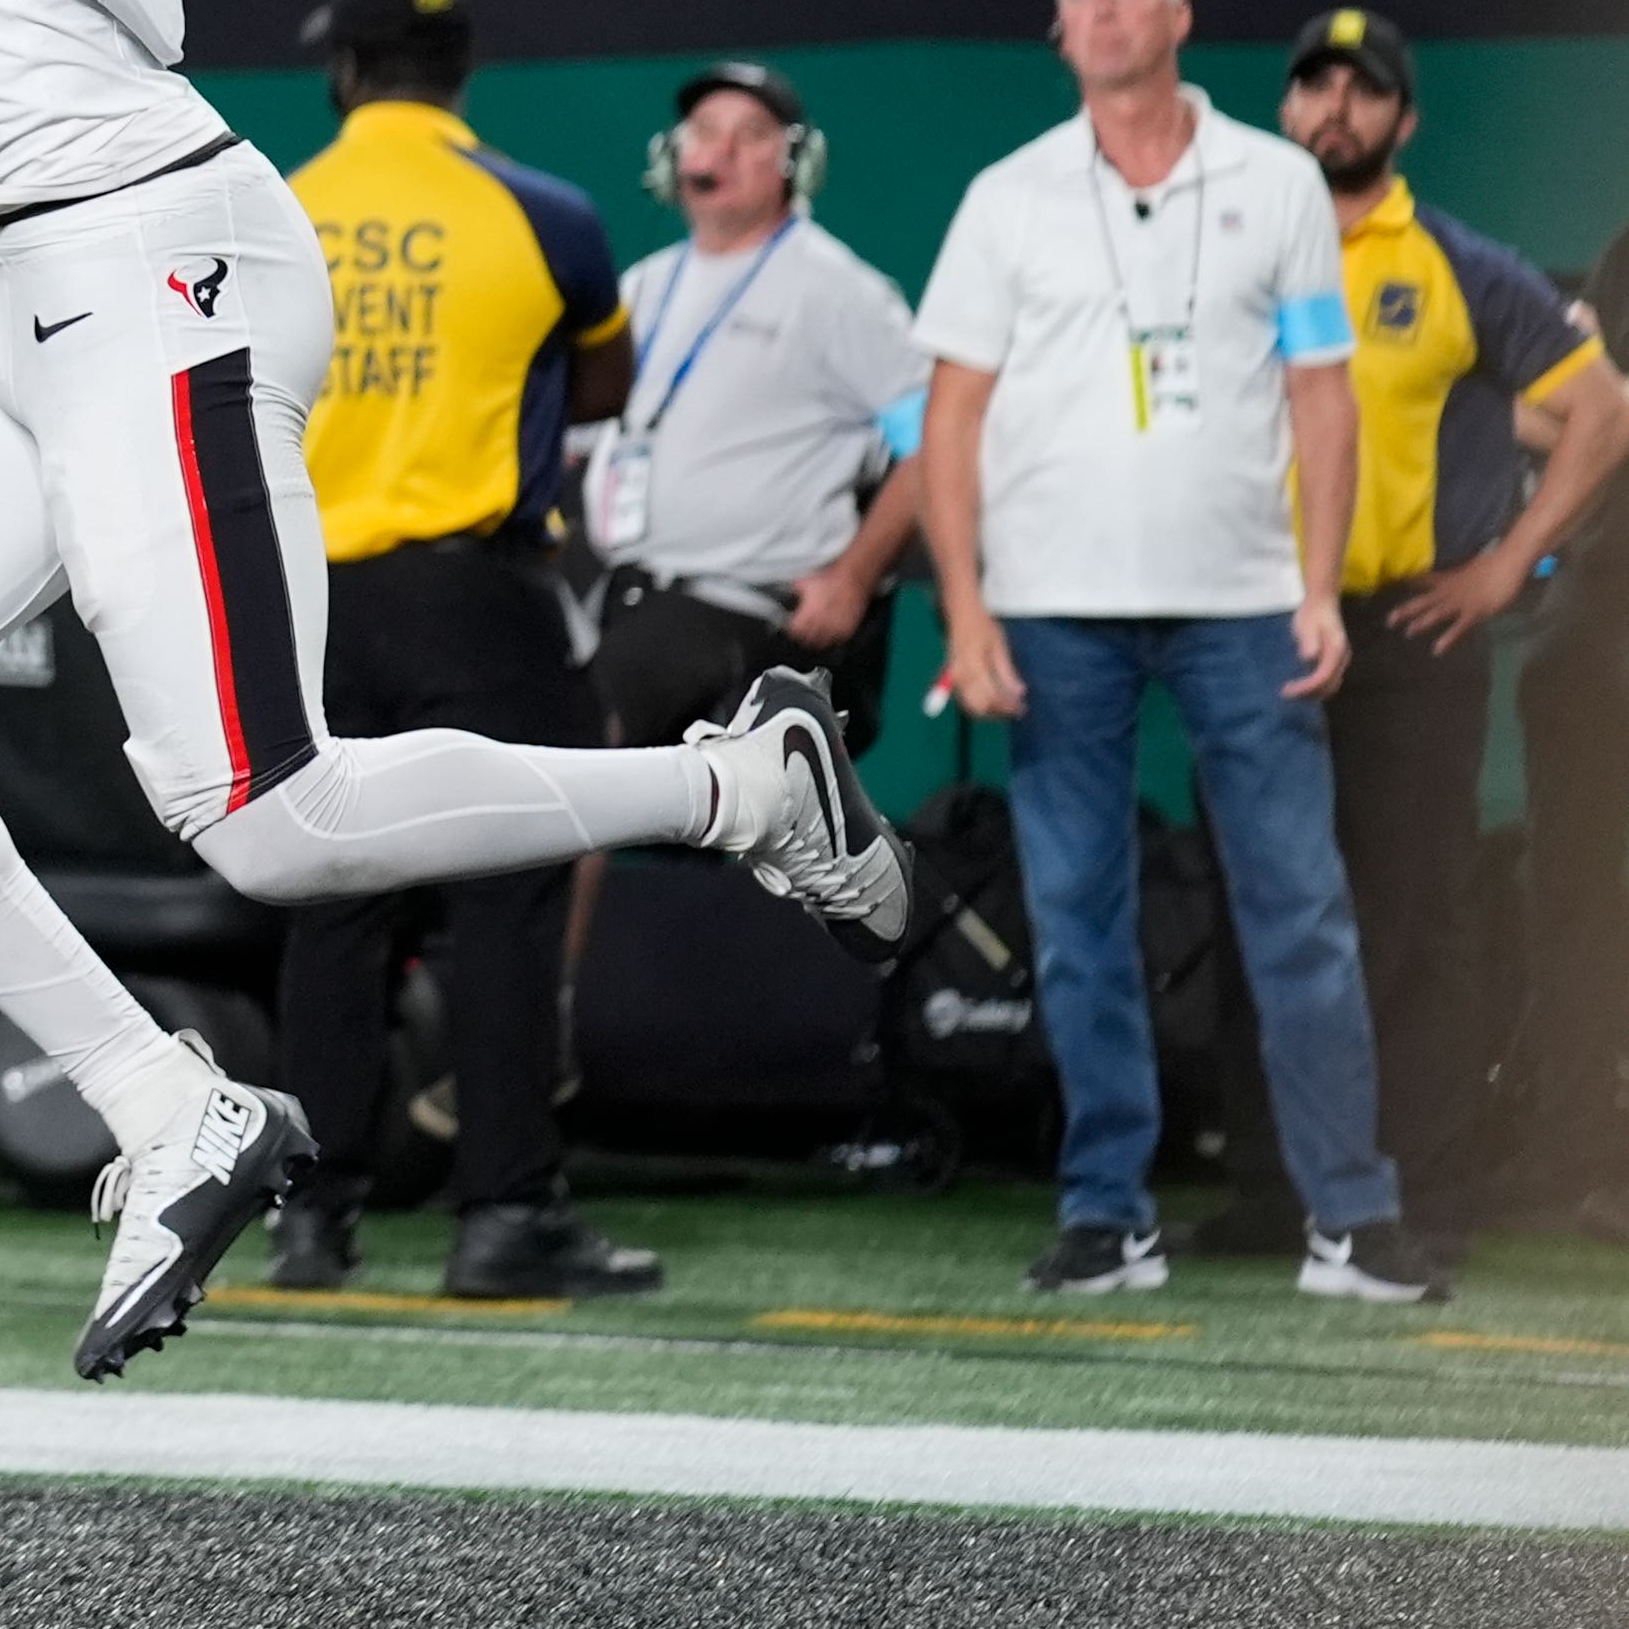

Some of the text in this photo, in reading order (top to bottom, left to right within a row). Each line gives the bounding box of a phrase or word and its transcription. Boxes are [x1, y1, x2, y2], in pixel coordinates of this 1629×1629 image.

[333, 282, 444, 336] VENT
[321, 344, 437, 396] TAFF
[191, 1088, 251, 1186] NIKE
